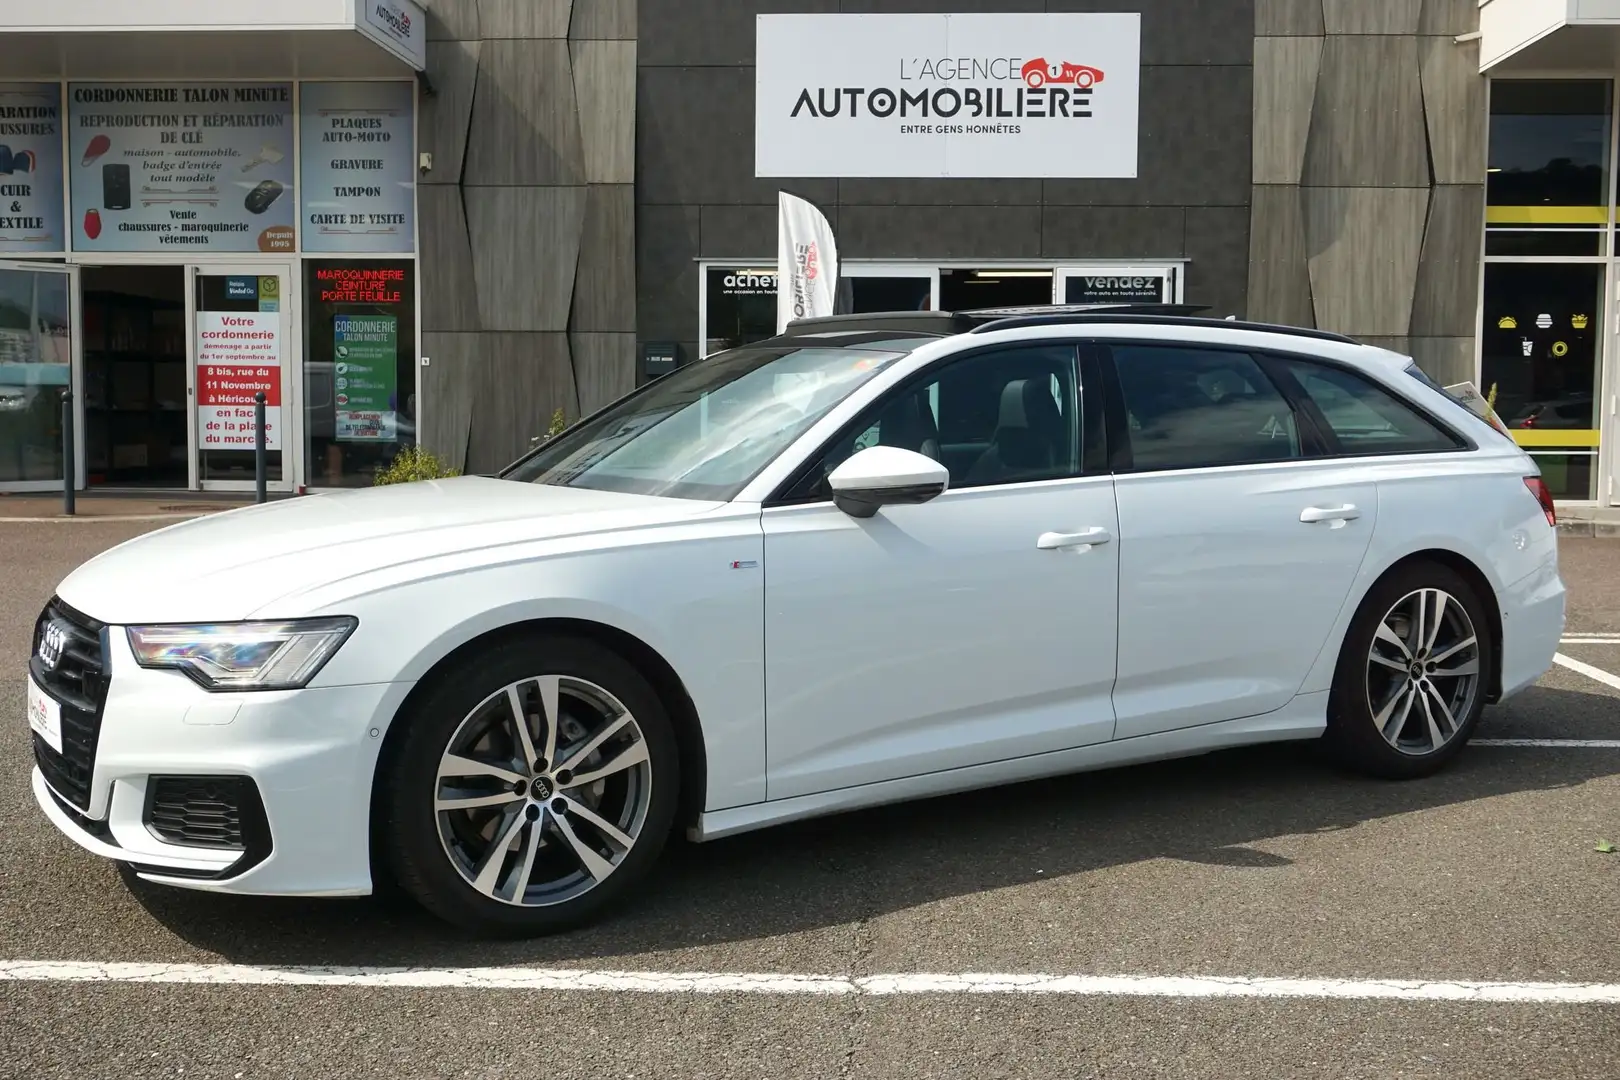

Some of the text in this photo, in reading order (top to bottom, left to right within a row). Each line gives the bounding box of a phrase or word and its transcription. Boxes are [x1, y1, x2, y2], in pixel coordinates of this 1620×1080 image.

[900, 58, 1021, 80] L'AGENCE
[74, 88, 289, 103] CORDONNERIE TALON MINUTE
[80, 112, 284, 127] REPRODUCTION ET RÉPARATION
[332, 118, 382, 129] PLAQUES
[900, 122, 1021, 134] ENTRE GENS HONNÊTES
[160, 131, 178, 144] DE
[322, 132, 391, 142] AUTO-MOTO
[123, 148, 164, 157] maison
[142, 160, 222, 172] badge d'entrée
[330, 159, 384, 169] GRAVURE
[150, 174, 216, 183] tout modèle
[0, 184, 32, 197] CUIR
[333, 186, 381, 197] TAMPON
[10, 200, 22, 213] &
[169, 210, 197, 220] Vente
[310, 213, 406, 224] CARTE DE VISITE
[0, 216, 44, 229] EXTILE
[118, 222, 172, 232] chaussures
[181, 222, 249, 233] maroquinerie
[158, 234, 209, 244] vêtements
[317, 270, 404, 280] MAROQUINNERIE
[336, 280, 385, 291] CEINTURE
[1084, 276, 1155, 289] vendez
[322, 292, 400, 301] PORTE FEUILLE
[221, 316, 254, 326] Votre
[335, 321, 396, 333] CORDONNERIE
[201, 329, 274, 340] cordonnerie
[343, 333, 388, 342] TALON MINUTE
[207, 367, 214, 376] 8
[216, 368, 235, 377] bis,
[256, 368, 269, 376] du
[206, 381, 271, 390] 11 Novembre
[208, 394, 215, 403] à
[216, 409, 231, 417] en
[206, 421, 272, 432] de la plae
[205, 434, 220, 443] du
